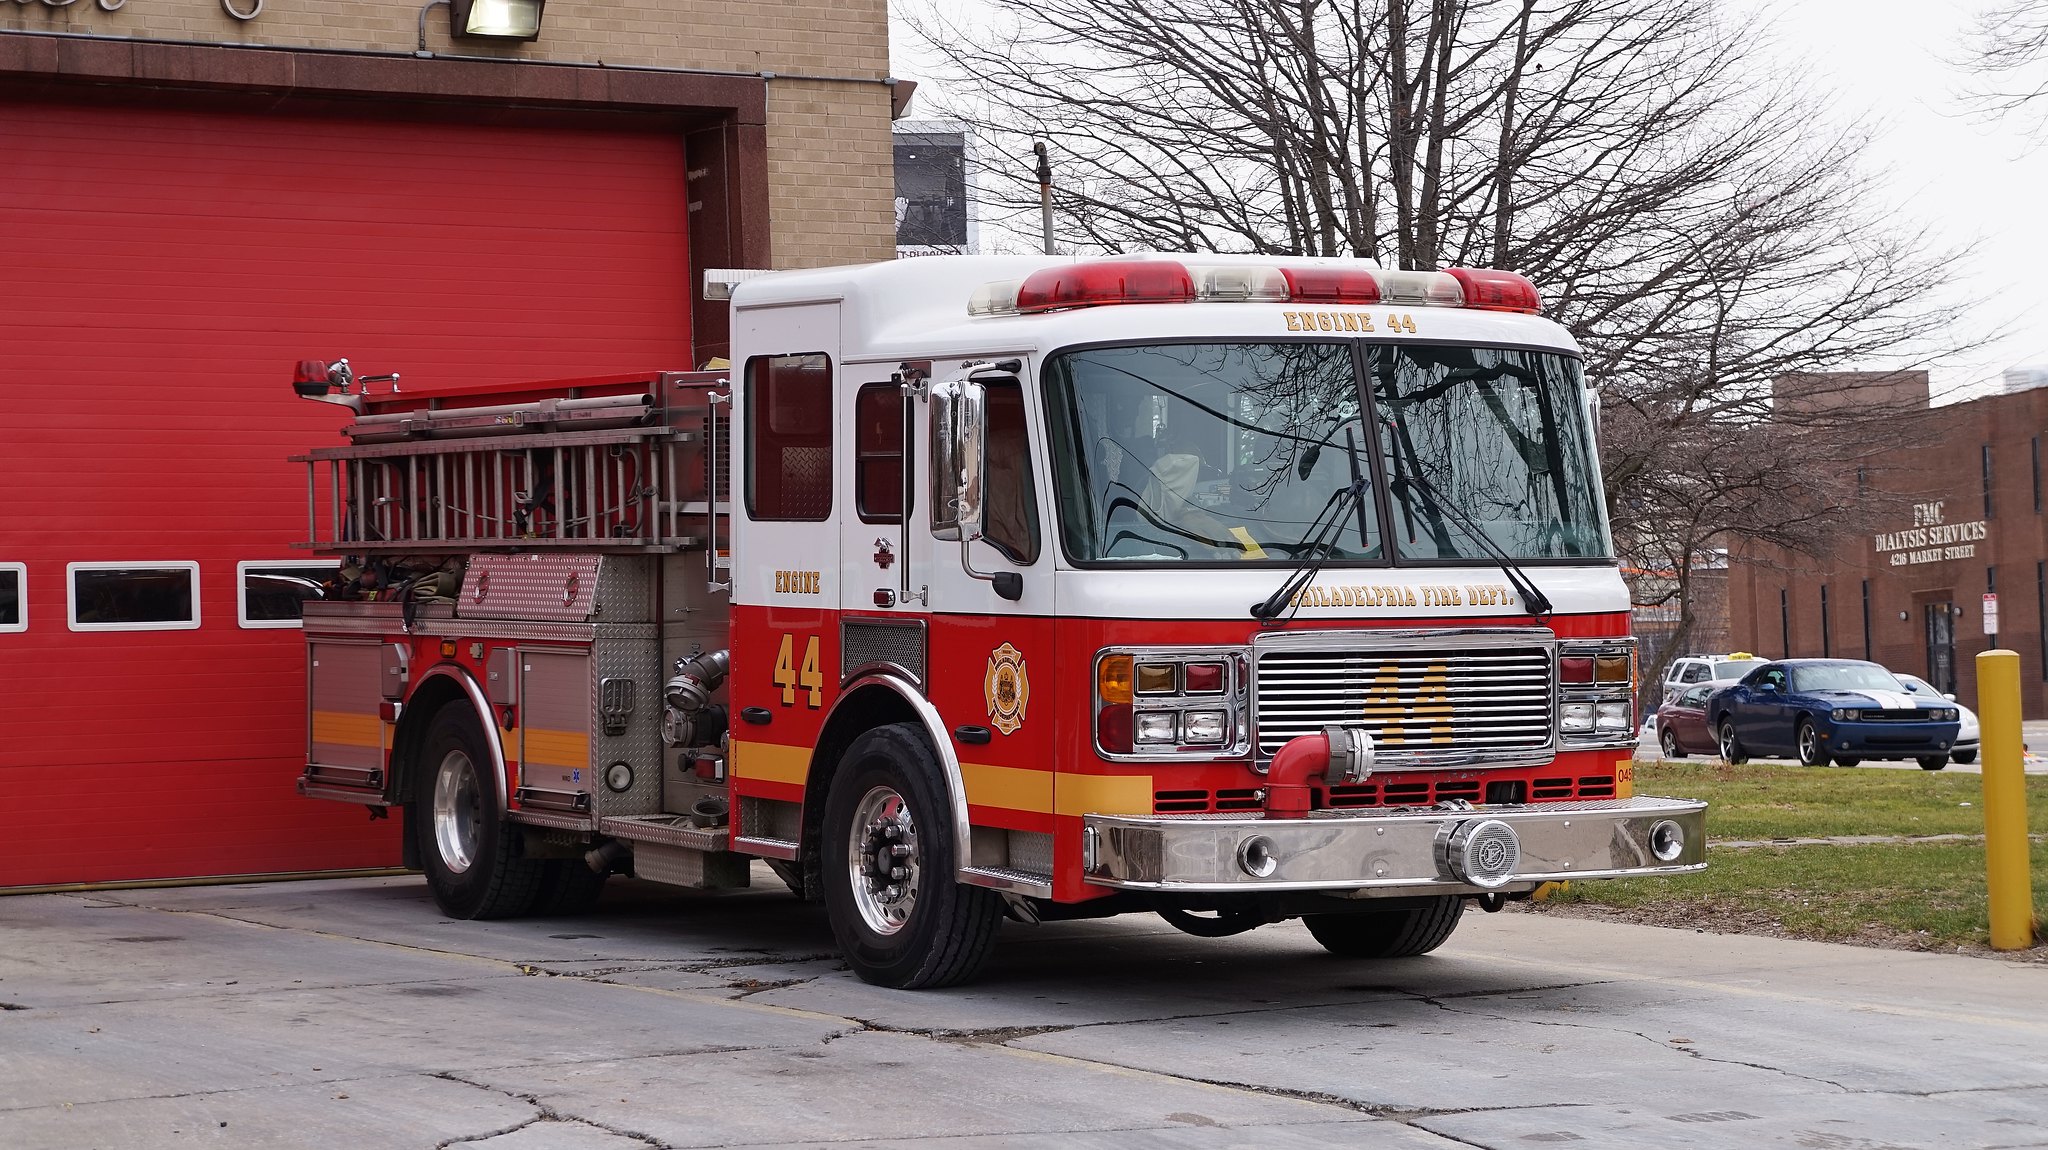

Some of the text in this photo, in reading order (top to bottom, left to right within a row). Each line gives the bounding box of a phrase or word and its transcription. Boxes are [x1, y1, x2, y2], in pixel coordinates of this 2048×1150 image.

[1283, 311, 1417, 333] ENGINE 44
[1913, 501, 1945, 527] FMC
[1875, 521, 1986, 552] DIALYSIS SERVICES
[1889, 544, 1975, 566] 4216 MARKET STREET
[775, 570, 820, 593] ENGINE
[1420, 585, 1462, 606] FIRE
[1464, 584, 1514, 605] DEPT.
[773, 632, 823, 710] 44
[1363, 658, 1454, 744] 44
